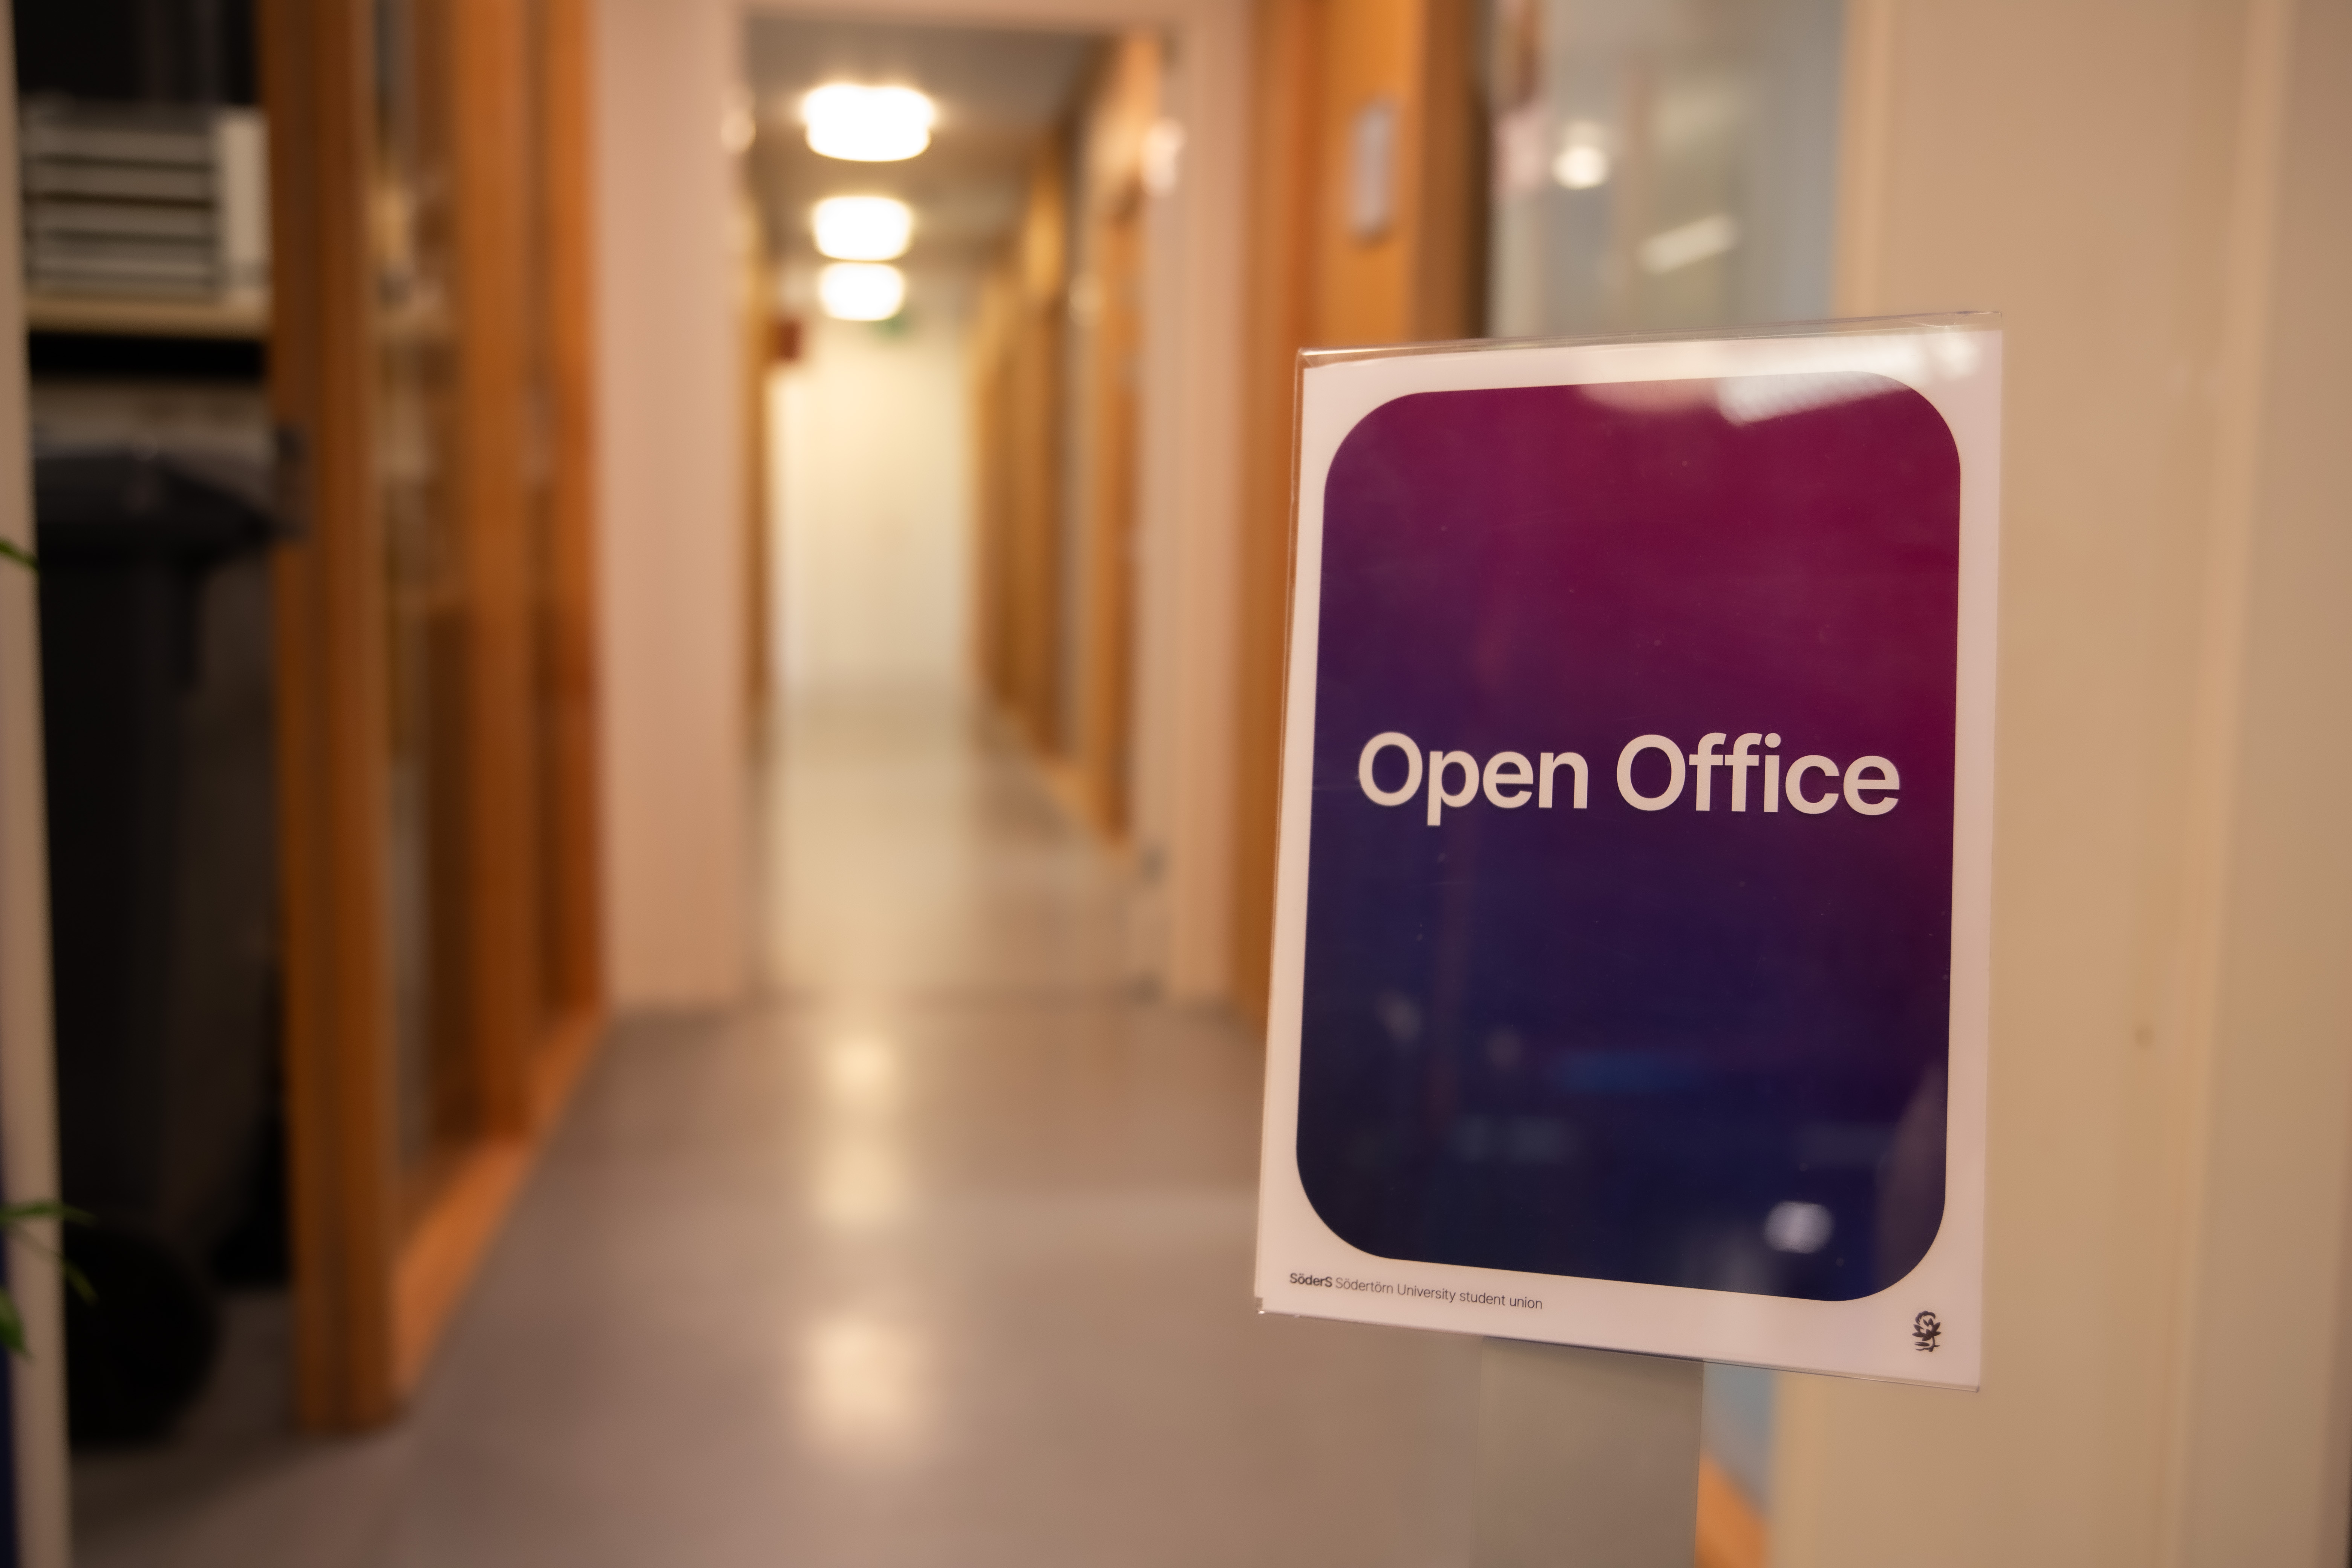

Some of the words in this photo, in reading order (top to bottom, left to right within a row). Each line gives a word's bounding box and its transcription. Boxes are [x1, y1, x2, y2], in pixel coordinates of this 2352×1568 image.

[1358, 731, 1589, 827] Open
[1616, 732, 1900, 816] Office
[1289, 1272, 1332, 1288] SöderS
[1335, 1277, 1393, 1294] Södertörn
[1397, 1283, 1456, 1303] University
[1459, 1291, 1505, 1307] student
[1510, 1297, 1542, 1309] union
